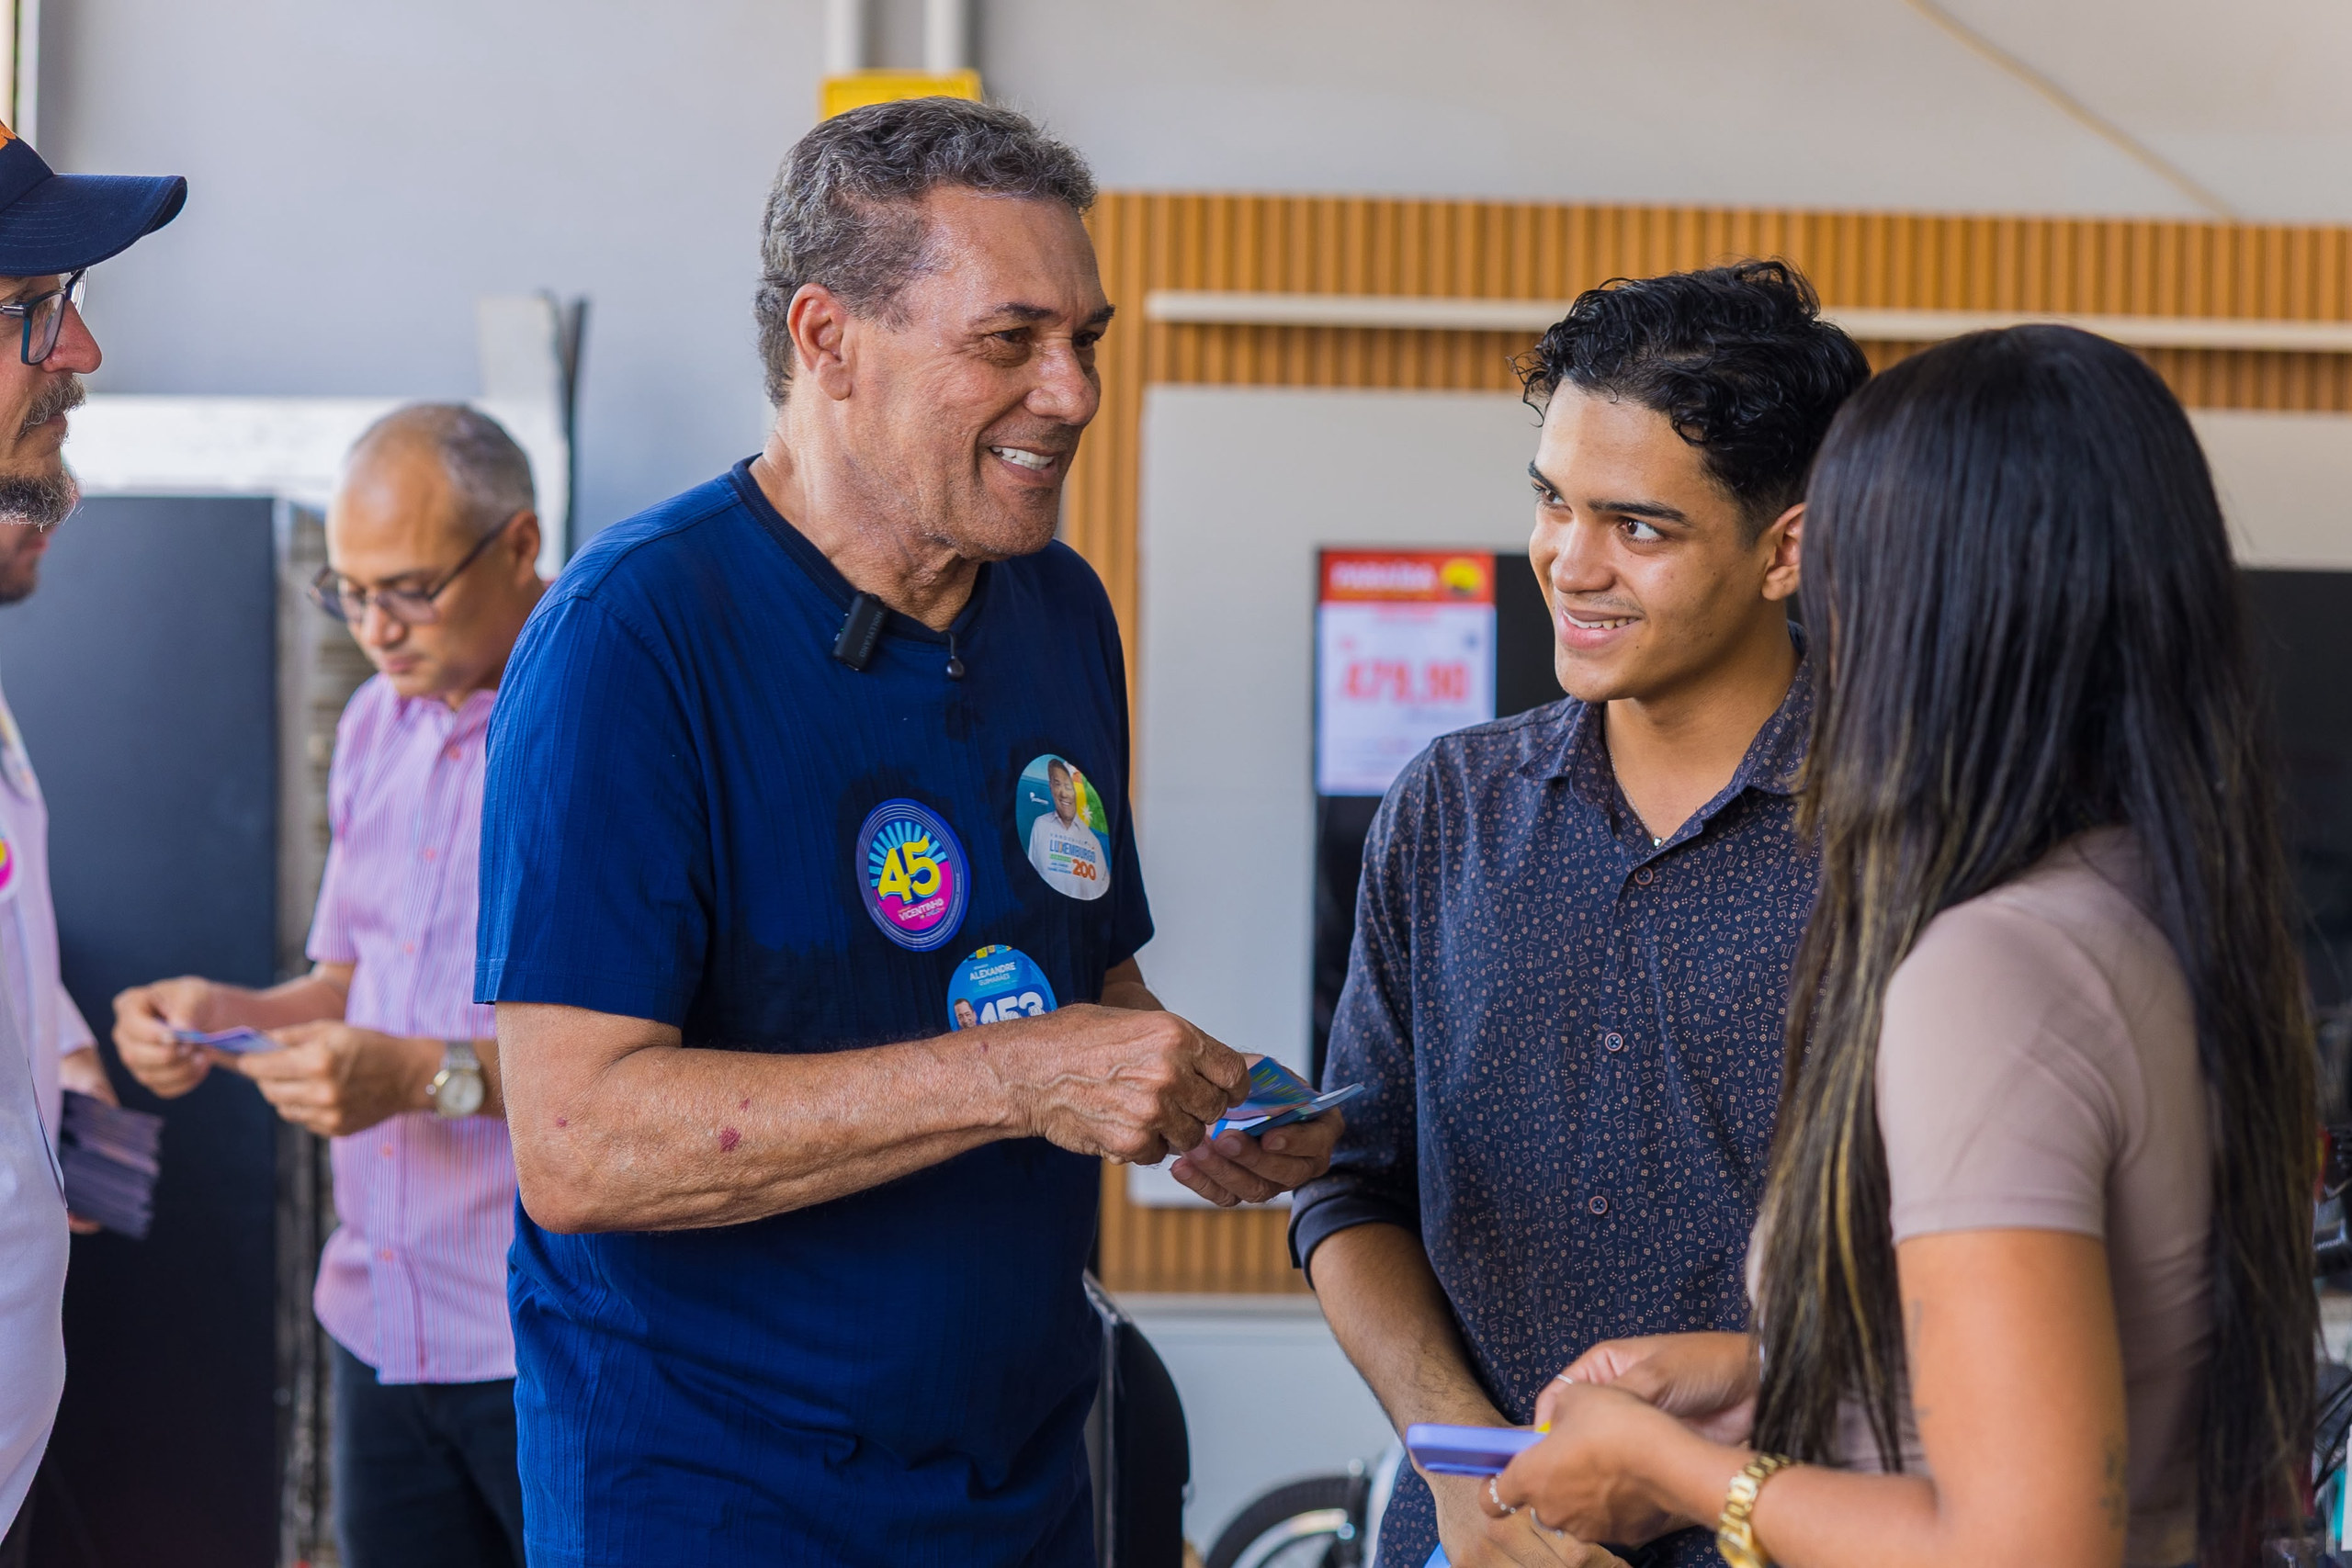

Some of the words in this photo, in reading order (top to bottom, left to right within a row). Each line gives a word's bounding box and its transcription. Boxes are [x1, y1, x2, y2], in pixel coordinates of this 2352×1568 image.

[859, 611, 883, 658] HOLLYLAND
[878, 835, 941, 902] 45
[1072, 858, 1096, 881] 200
[899, 898, 944, 921] VICENTINHO
[969, 962, 1016, 981] ALEXANDRE
